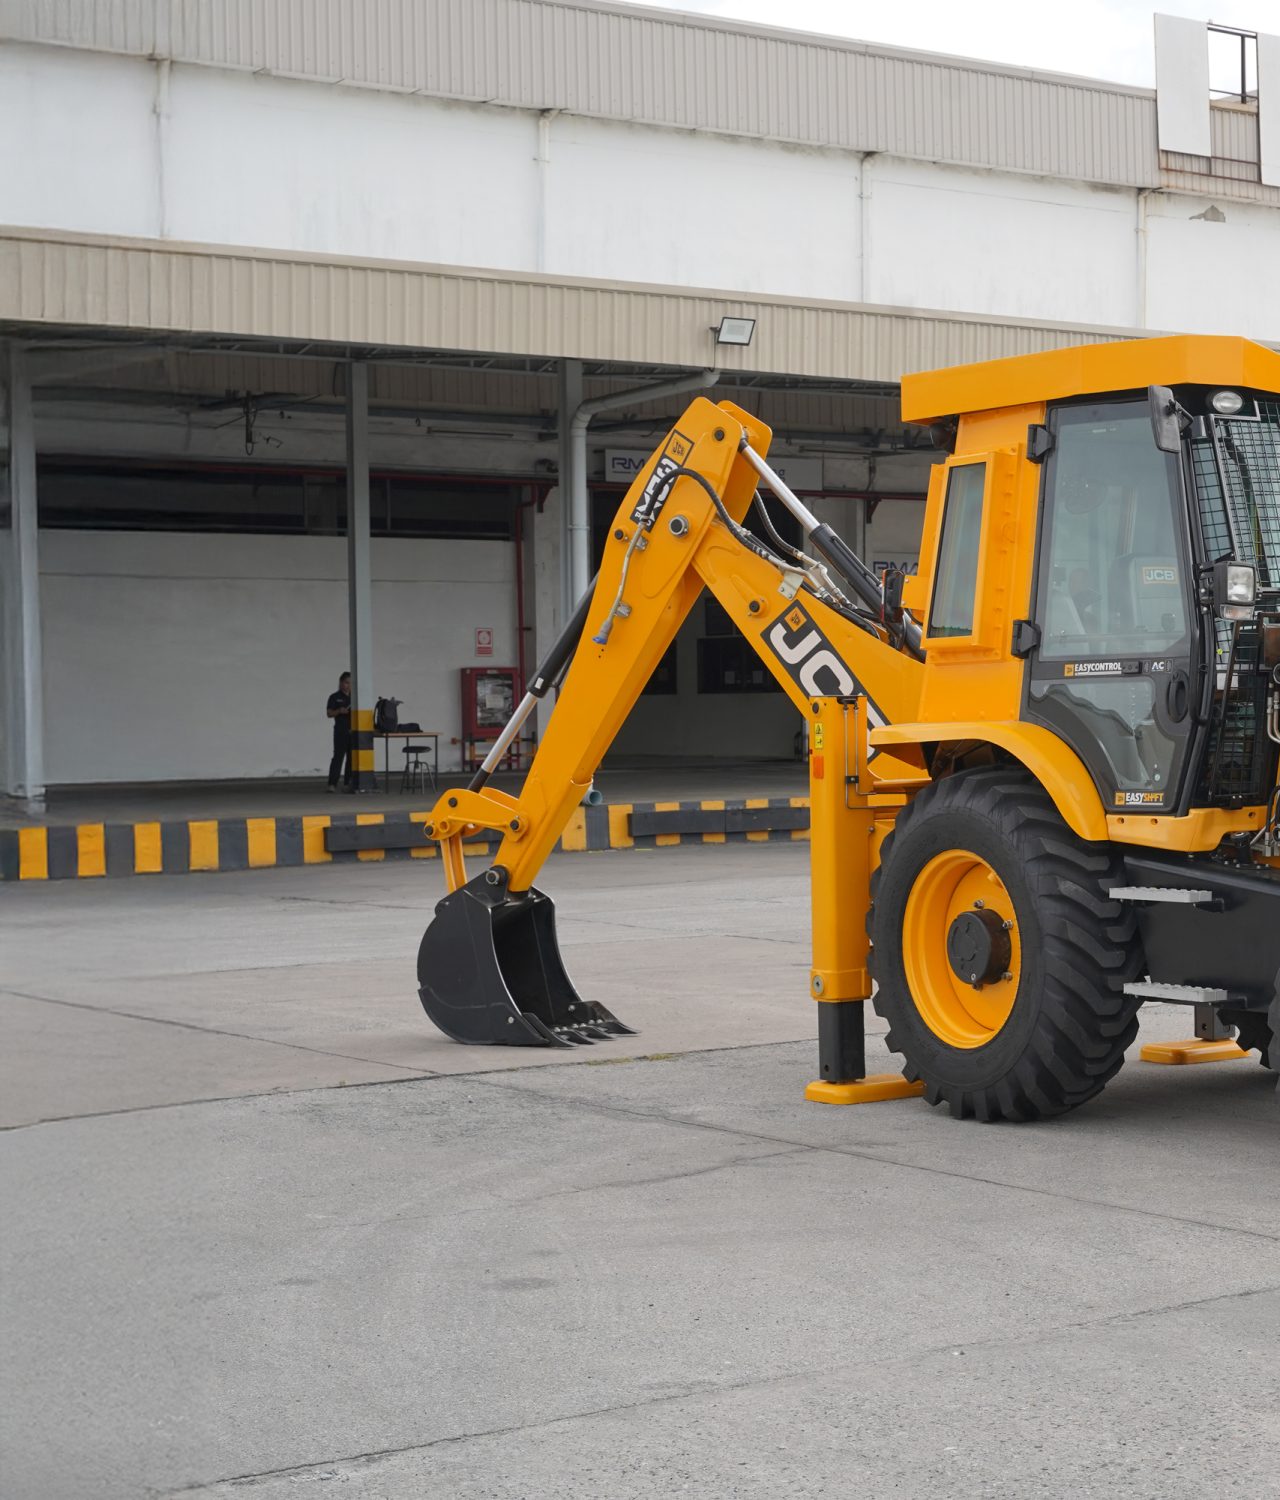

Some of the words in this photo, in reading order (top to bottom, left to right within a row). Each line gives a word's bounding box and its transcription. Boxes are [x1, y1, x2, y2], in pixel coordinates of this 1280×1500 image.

[612, 456, 645, 470] RM
[1146, 569, 1175, 581] JCB
[1075, 662, 1122, 672] EASYCONTROL
[1151, 661, 1165, 670] AC
